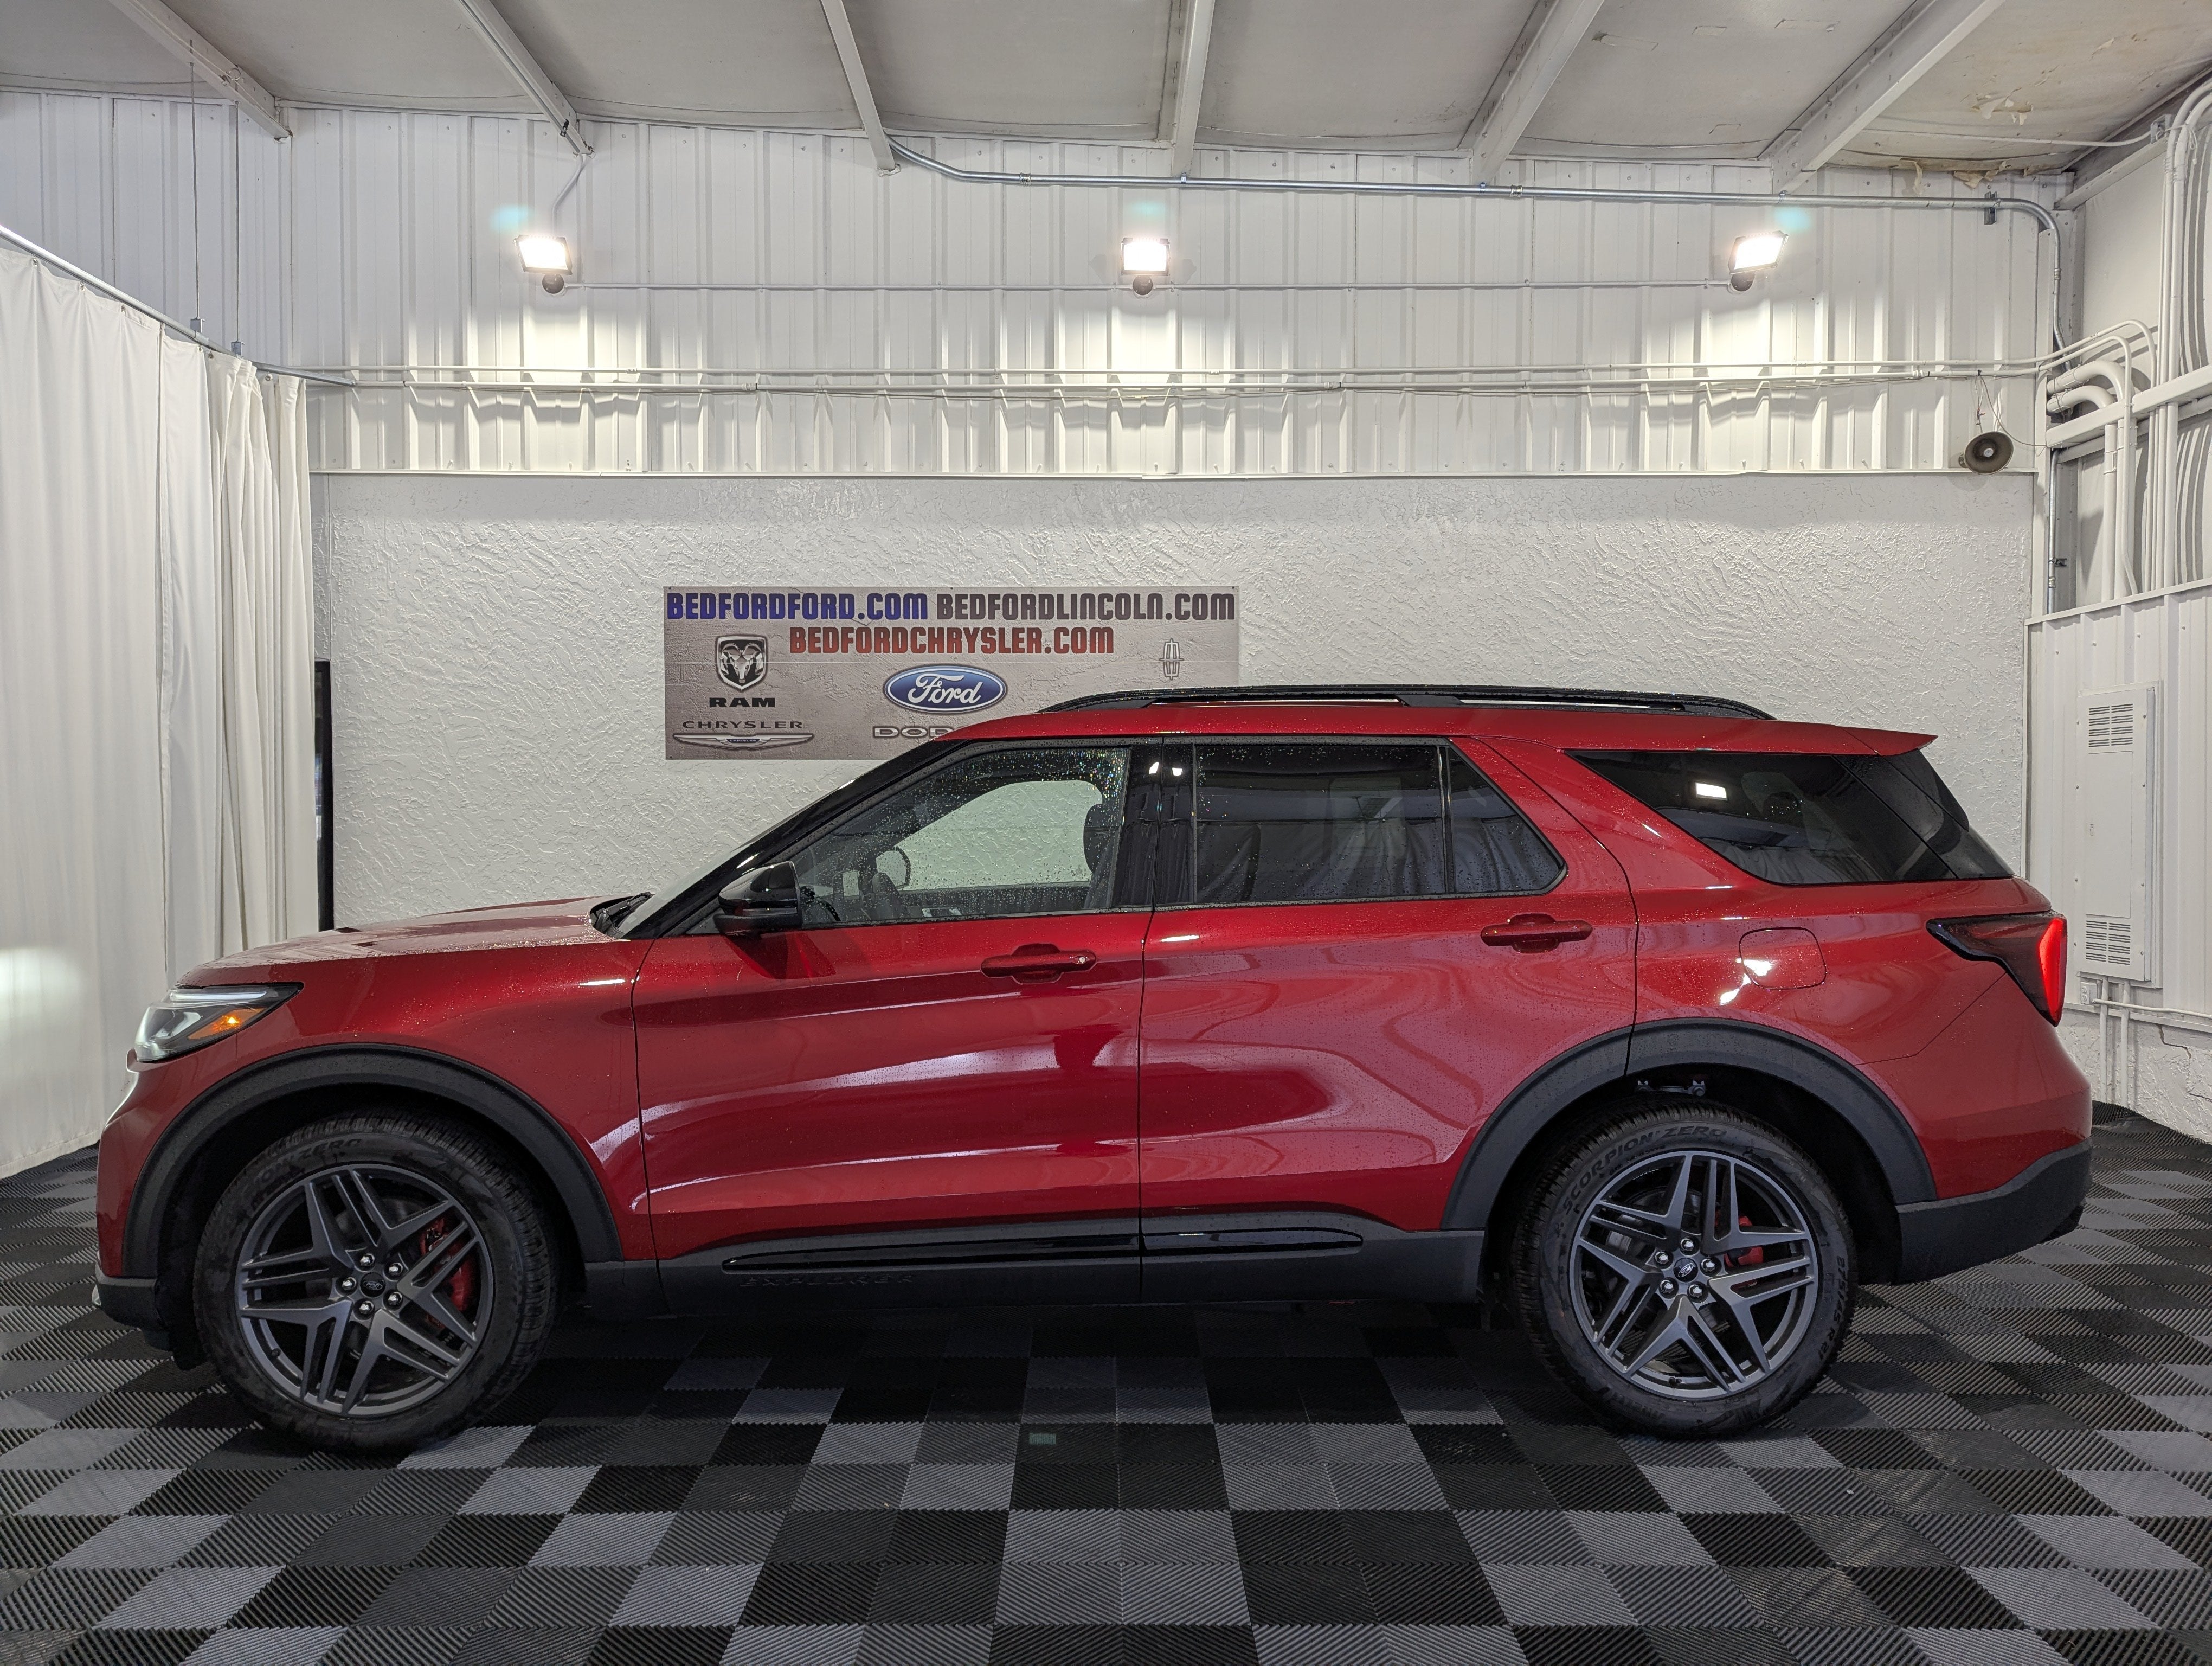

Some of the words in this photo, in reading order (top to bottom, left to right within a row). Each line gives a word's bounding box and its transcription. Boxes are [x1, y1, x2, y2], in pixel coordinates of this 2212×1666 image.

[667, 593, 928, 620] BEDFORDFORD.COM
[937, 593, 1235, 620] BEDFORDLINCOLN.COM
[789, 627, 1114, 654] BEDFORDCHRYSLER.COM
[908, 673, 983, 704] Ford
[709, 697, 775, 708] RAM
[682, 721, 803, 729] CHRYSLER
[874, 727, 956, 738] DOD
[1562, 1131, 1654, 1215] SCORPION
[1660, 1125, 1727, 1139] ZERO
